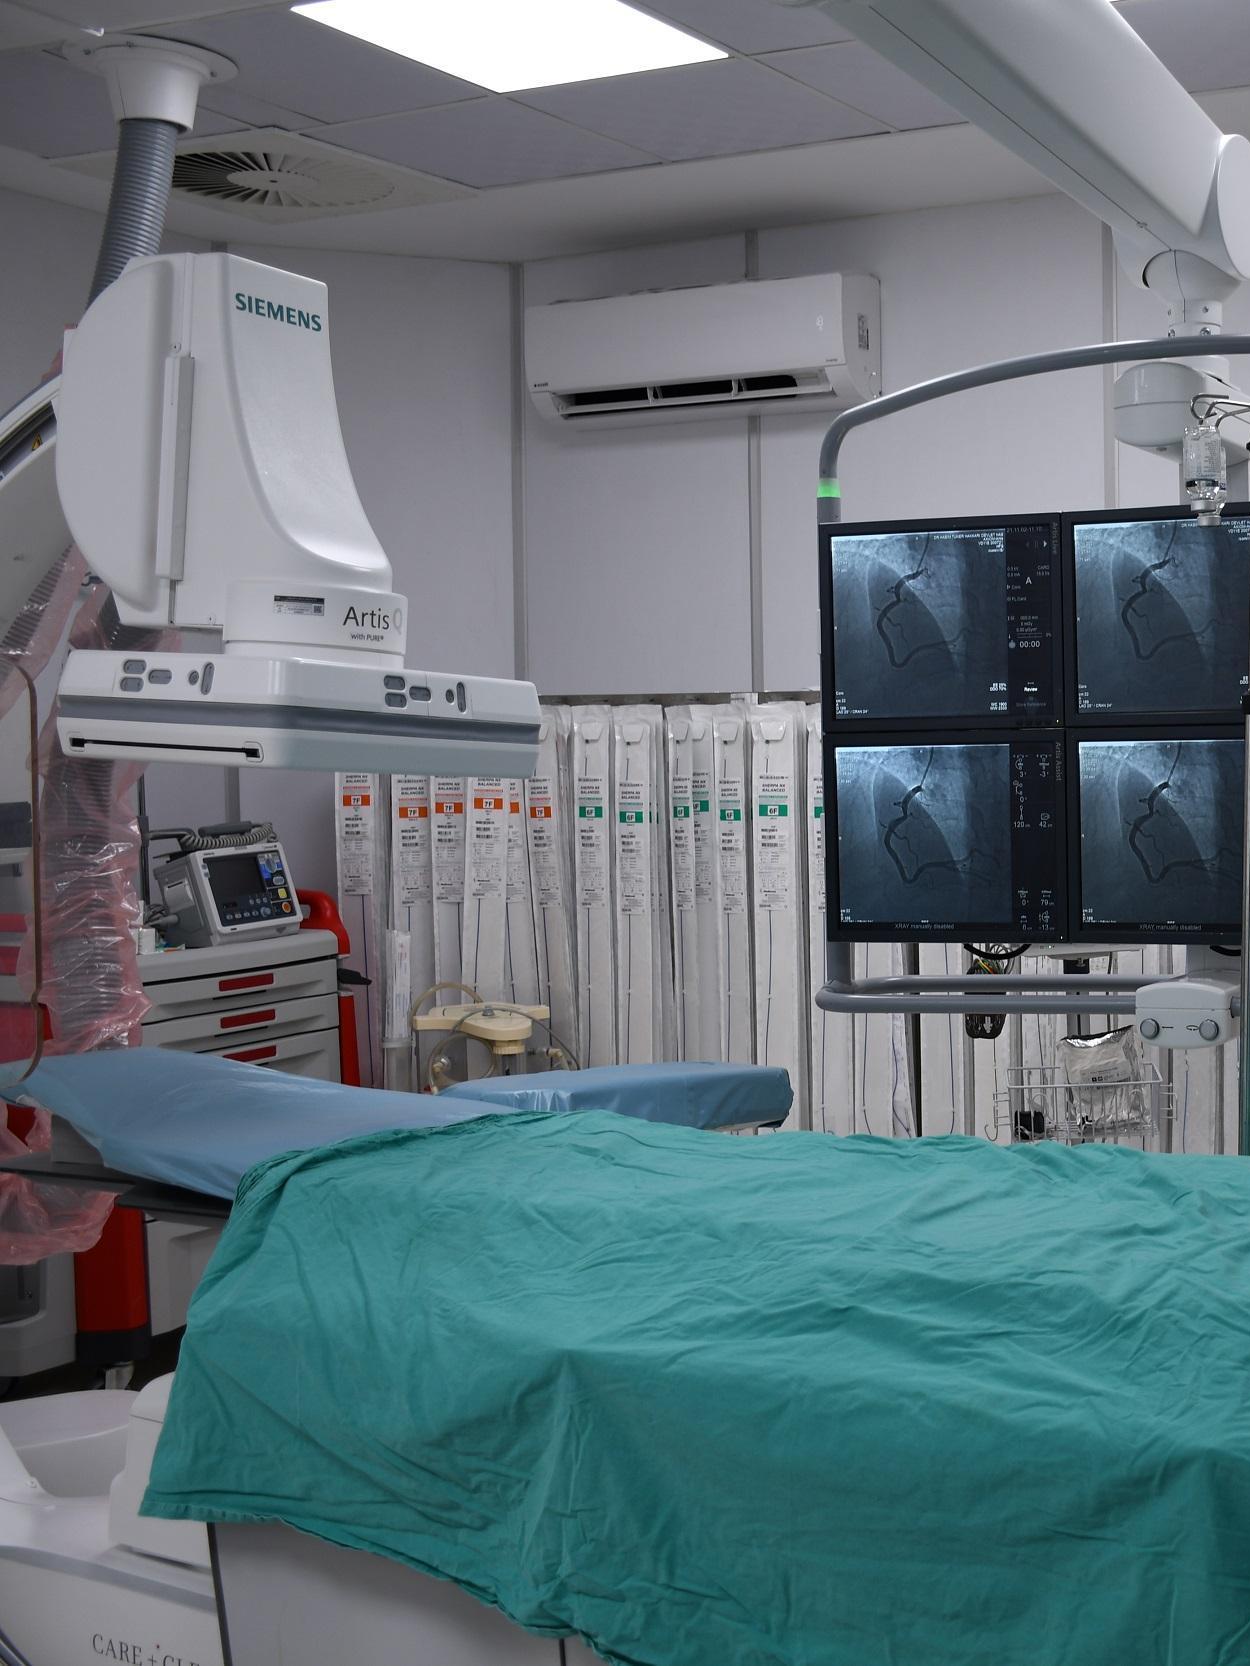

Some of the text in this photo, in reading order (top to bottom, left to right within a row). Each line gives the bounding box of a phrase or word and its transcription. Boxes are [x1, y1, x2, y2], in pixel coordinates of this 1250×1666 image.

[235, 292, 322, 332] SIEMENS
[1025, 576, 1033, 585] A
[343, 606, 390, 630] Artis
[1019, 640, 1041, 649] 00:00
[445, 804, 454, 812] 7F
[484, 800, 493, 808] 7F
[408, 808, 417, 816] 7F
[586, 808, 594, 816] 6F
[678, 808, 684, 816] 6F
[726, 811, 734, 819] 6F
[769, 807, 778, 815] 6F
[627, 814, 635, 822] 6F
[92, 1633, 142, 1666] CARE
